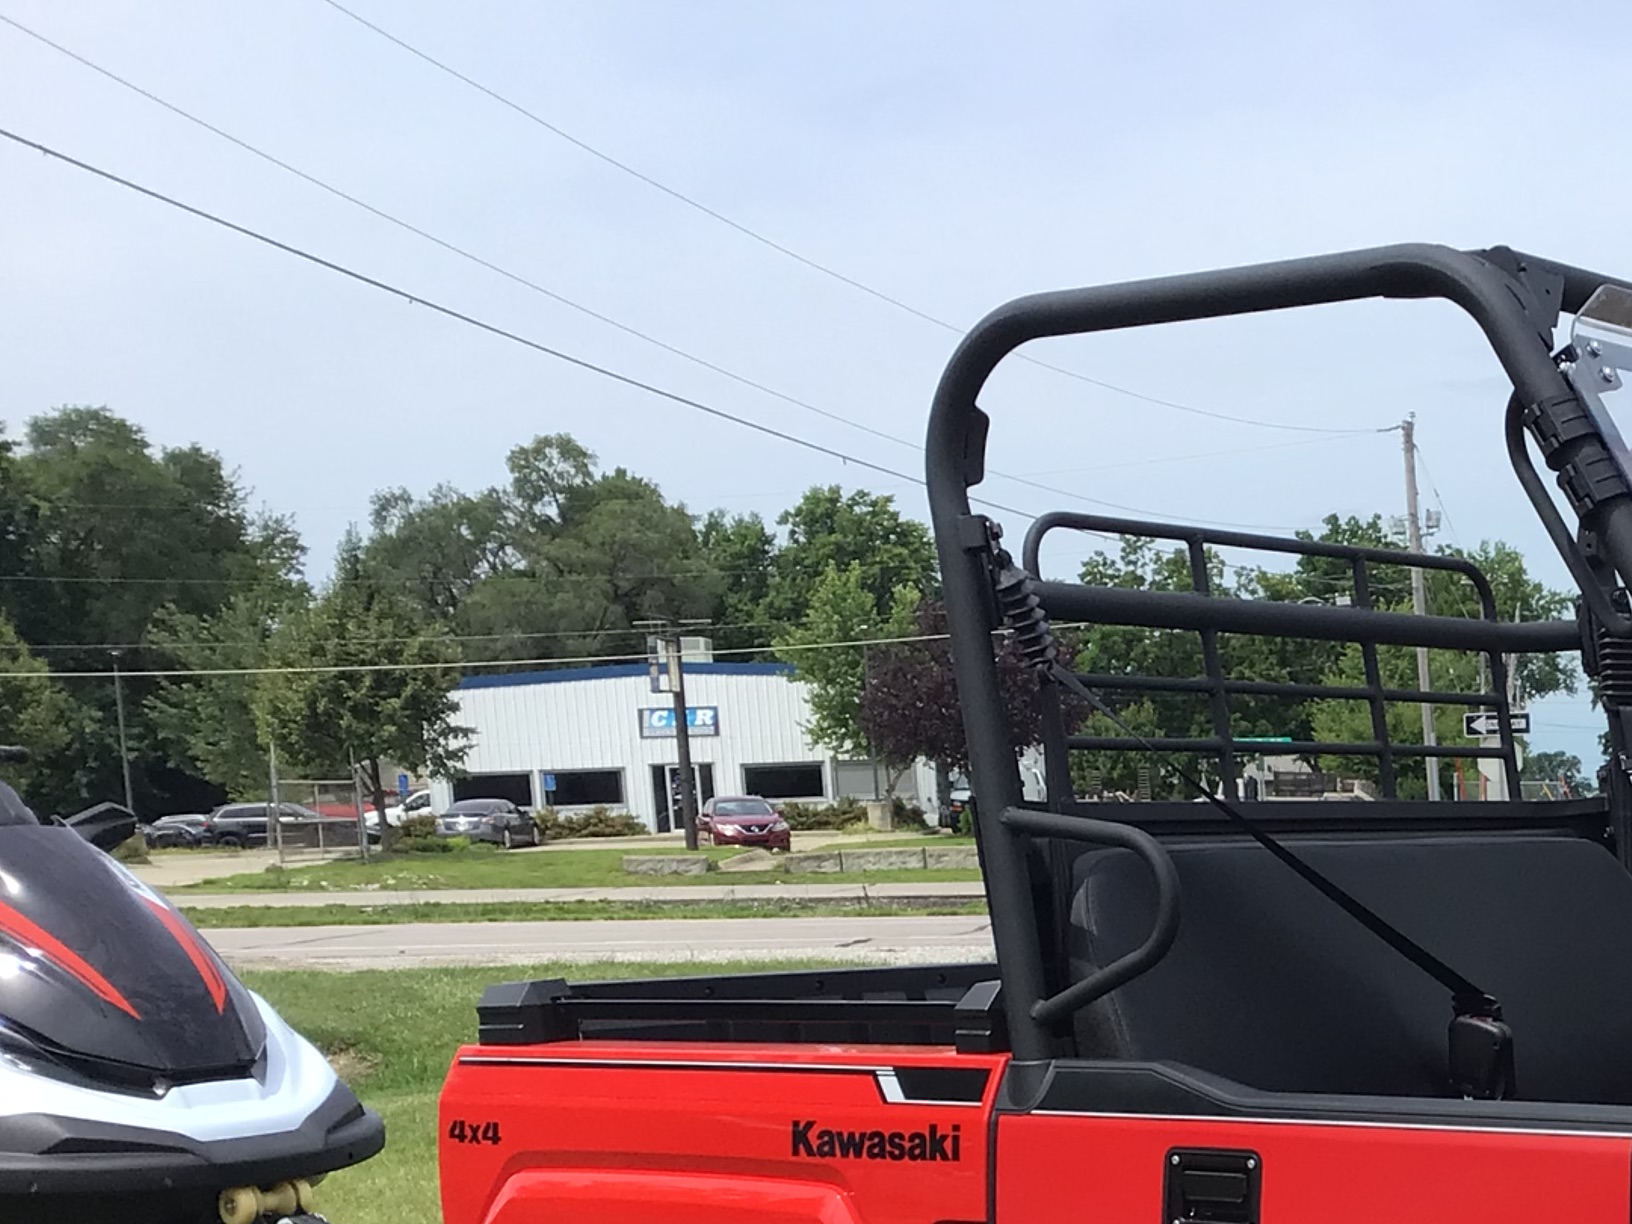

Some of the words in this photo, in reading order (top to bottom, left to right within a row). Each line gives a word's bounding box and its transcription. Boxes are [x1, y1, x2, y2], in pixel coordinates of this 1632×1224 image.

[650, 709, 714, 727] CR
[448, 1119, 502, 1145] 4x4
[791, 1119, 961, 1162] Kawasaki
